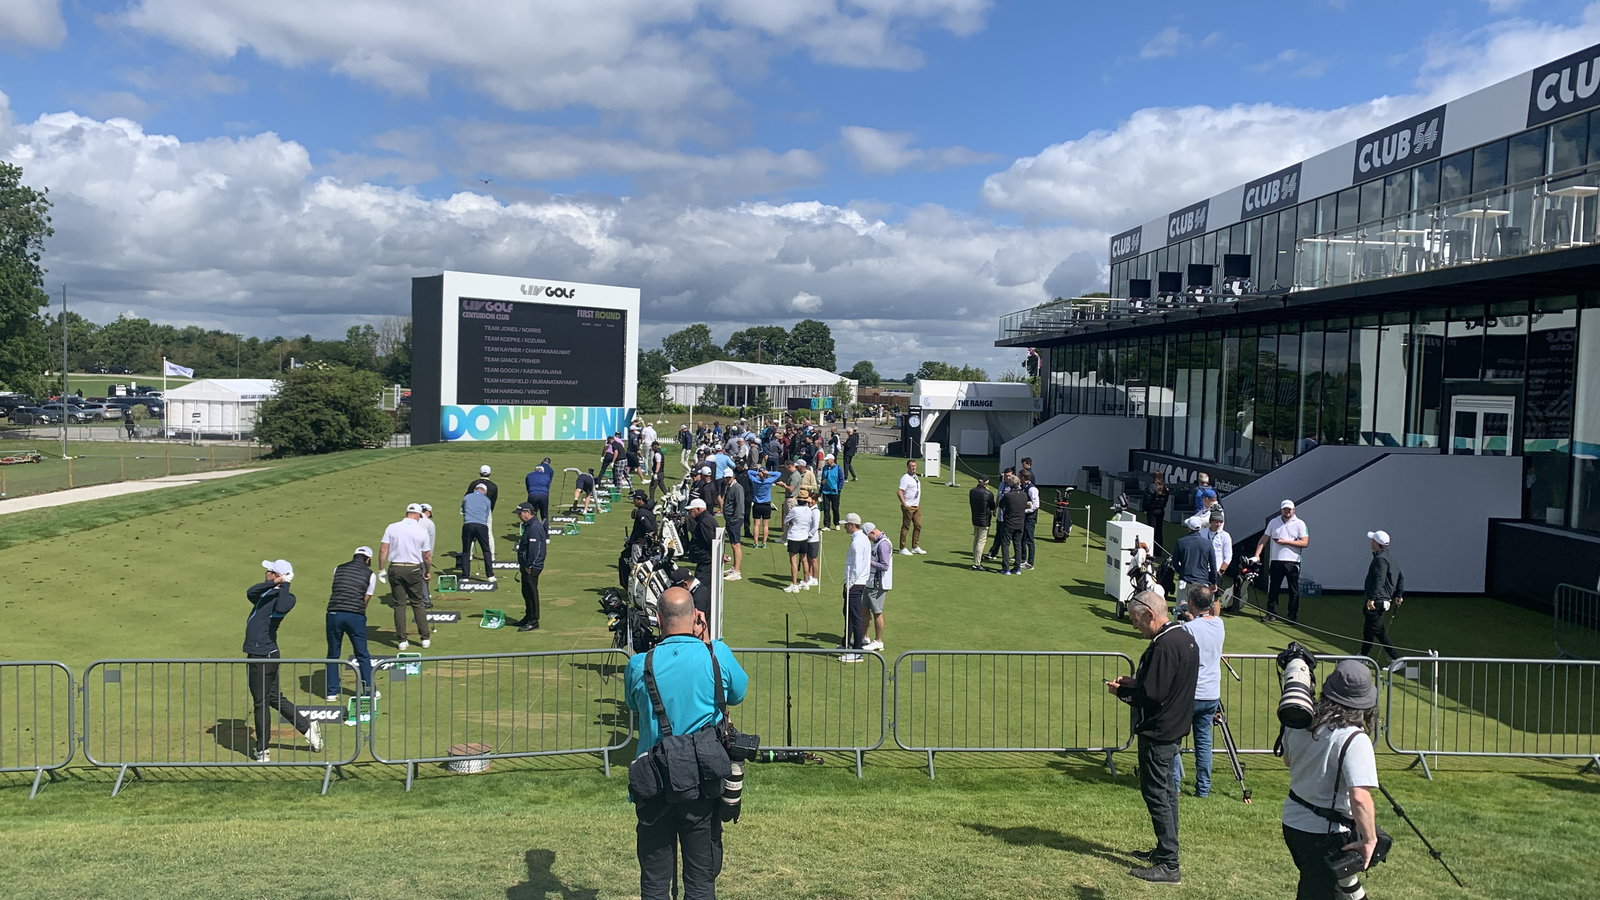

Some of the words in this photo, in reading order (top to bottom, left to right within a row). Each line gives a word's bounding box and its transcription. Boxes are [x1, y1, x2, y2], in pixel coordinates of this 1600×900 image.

[1358, 128, 1412, 173] CLUB
[1413, 117, 1439, 154] 54
[1245, 178, 1281, 212] CLUB
[1281, 171, 1298, 200] 54
[1169, 211, 1194, 238] CLUB
[1193, 206, 1207, 229] 54
[1112, 235, 1131, 258] CLUB
[1130, 231, 1141, 251] 54
[520, 284, 546, 296] LIV
[545, 286, 576, 299] GOLF
[462, 300, 487, 311] LIV
[485, 301, 514, 313] GOLF
[462, 311, 495, 320] CENTURION
[577, 309, 595, 319] FIRST
[595, 311, 621, 320] ROUND
[440, 405, 546, 440] DON'T
[555, 407, 637, 440] BLINK
[310, 710, 340, 720] GOLF
